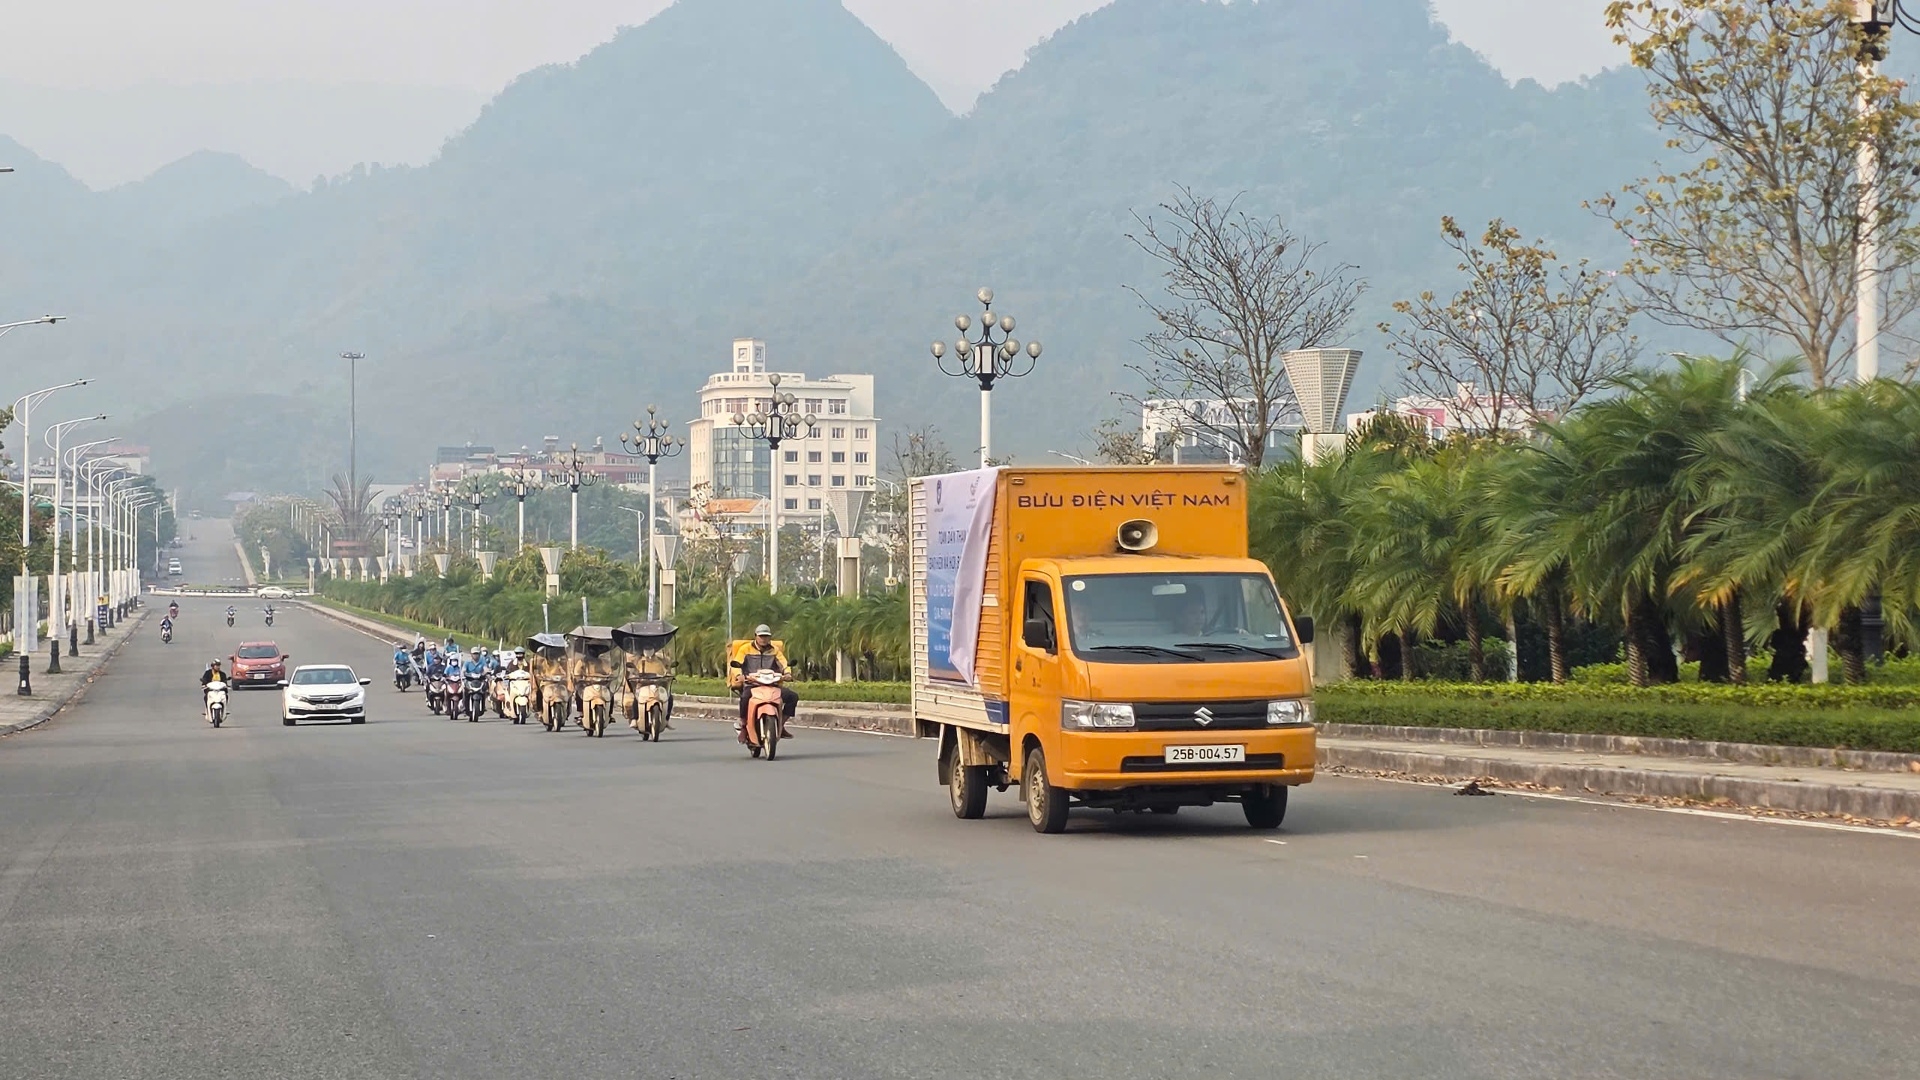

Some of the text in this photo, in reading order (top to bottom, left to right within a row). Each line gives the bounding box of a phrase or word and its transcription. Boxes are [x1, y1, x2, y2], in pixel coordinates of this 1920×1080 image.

[1018, 489, 1230, 510] BƯU ĐIỆN VIỆT NAM
